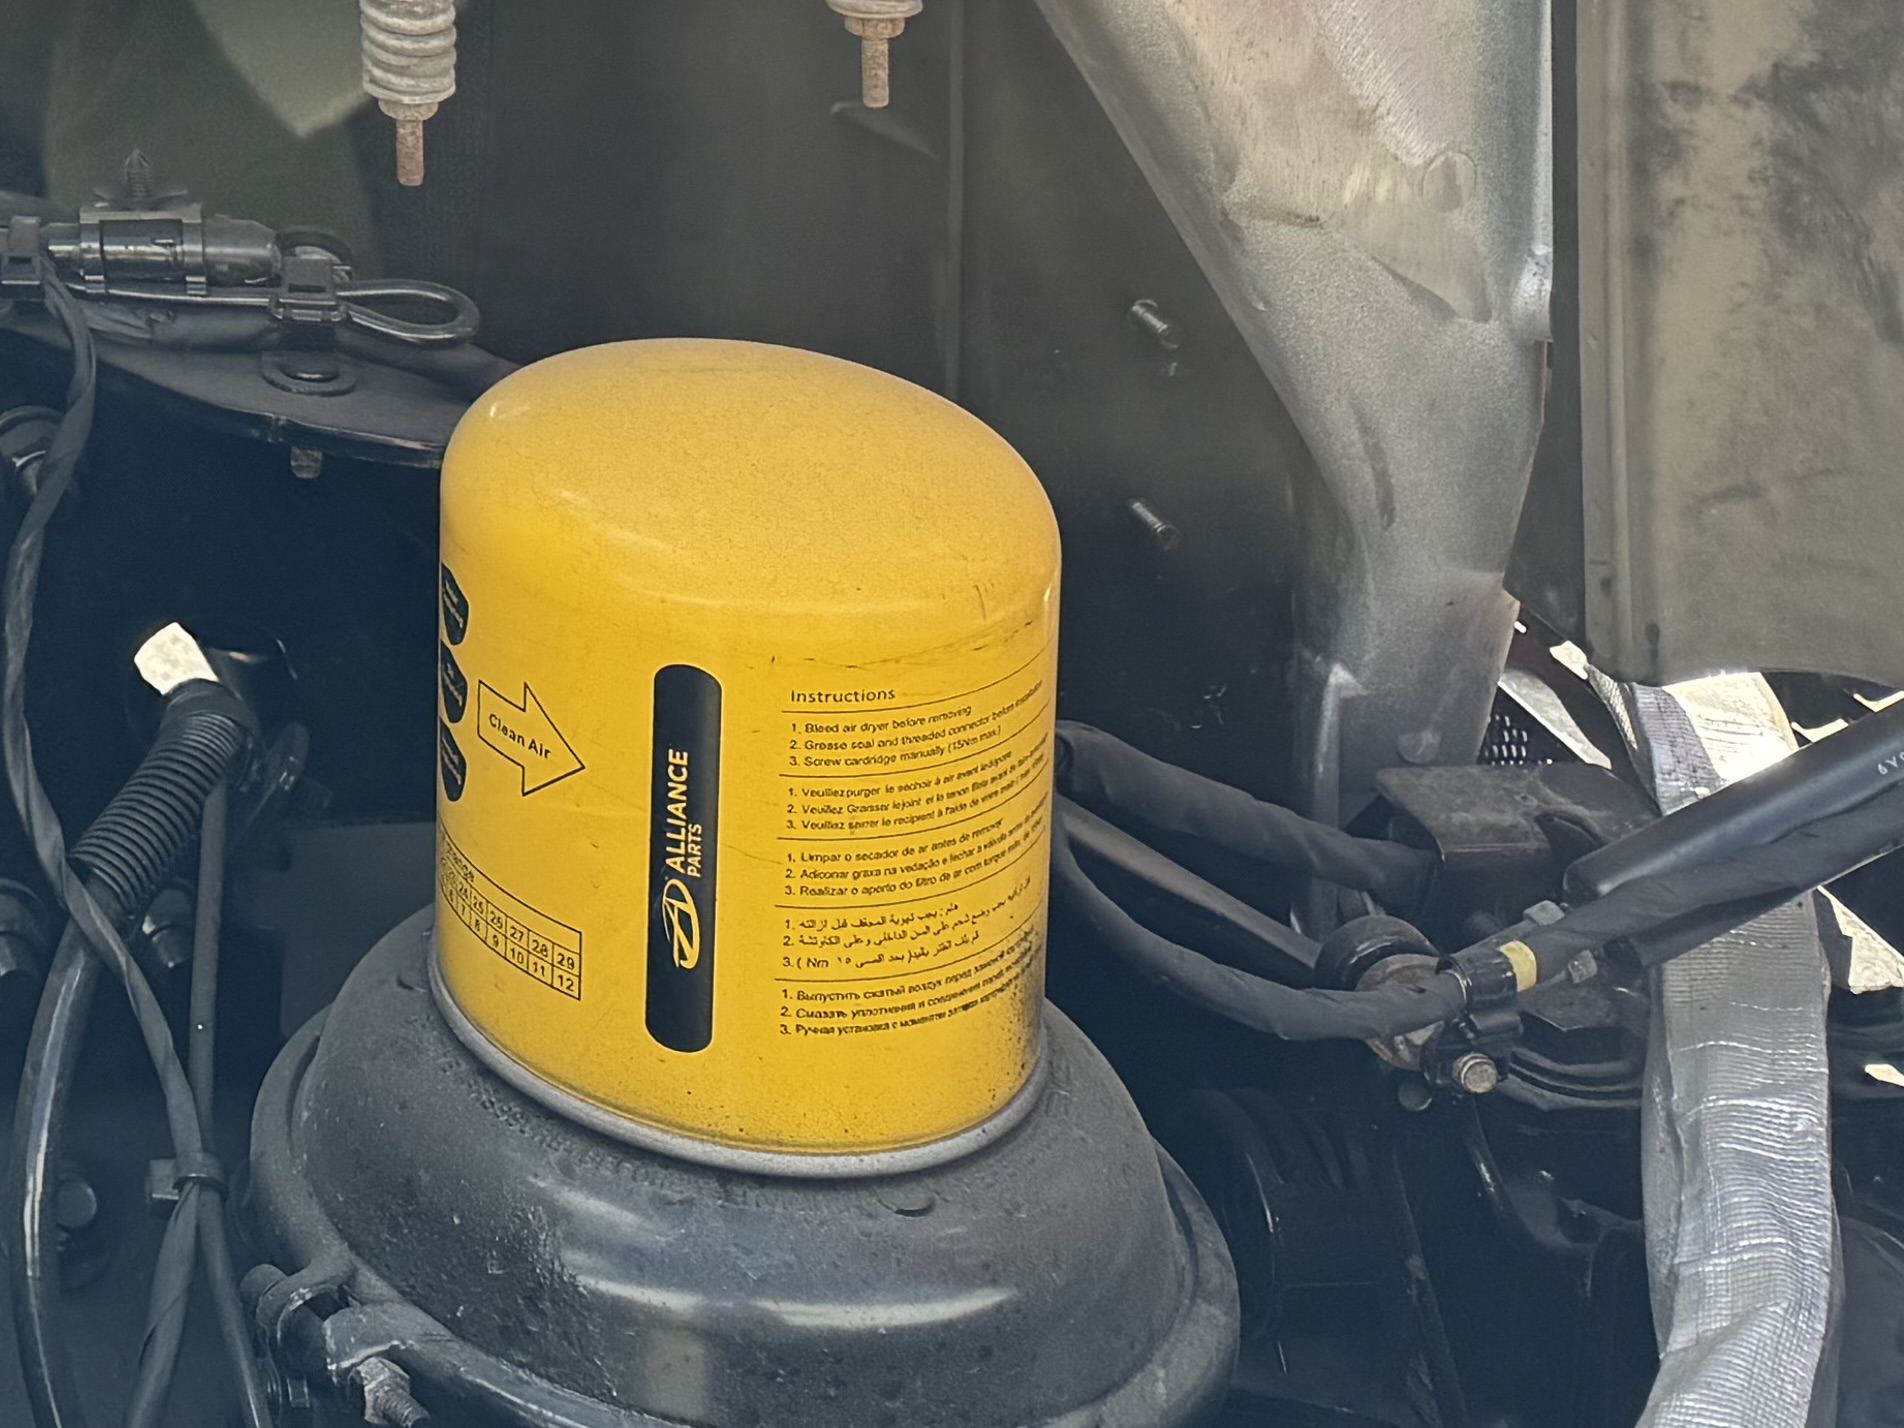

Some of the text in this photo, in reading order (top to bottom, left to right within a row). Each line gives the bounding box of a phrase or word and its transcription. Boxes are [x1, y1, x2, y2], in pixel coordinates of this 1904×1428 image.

[791, 688, 896, 703] Instructions
[791, 706, 972, 734] 1. Bleed air dryer before removing
[489, 713, 552, 760] Clean Air
[790, 740, 800, 750] 2.
[878, 736, 898, 748] and
[901, 728, 946, 746] threaded
[790, 756, 800, 766] 3.
[804, 756, 842, 767] Screw
[899, 746, 945, 762] manually
[788, 788, 797, 797] 1.
[666, 748, 688, 874] ALLIANCE
[787, 804, 796, 813] 2.
[786, 820, 796, 829] 3.
[687, 823, 702, 878] PARTS
[787, 853, 796, 863] 1.
[801, 852, 841, 864] Limpar
[844, 853, 852, 862] o
[855, 849, 898, 862] secador
[902, 846, 916, 856] de
[918, 844, 929, 855] ar
[785, 869, 796, 879] 2.
[884, 866, 897, 876] na
[785, 886, 796, 896] 3.
[800, 885, 848, 896] Realizar
[851, 887, 859, 895] o
[899, 880, 913, 891] do
[473, 896, 484, 914] 25
[509, 926, 524, 942] 27
[531, 939, 548, 958] 28
[557, 952, 575, 970] 29
[492, 934, 499, 948] 9
[510, 947, 524, 964] 10
[532, 961, 545, 977] 11
[558, 974, 575, 991] 12
[782, 957, 794, 967] 3.
[782, 989, 793, 999] 1.
[780, 1007, 791, 1017] 2.
[780, 1024, 791, 1034] 3.
